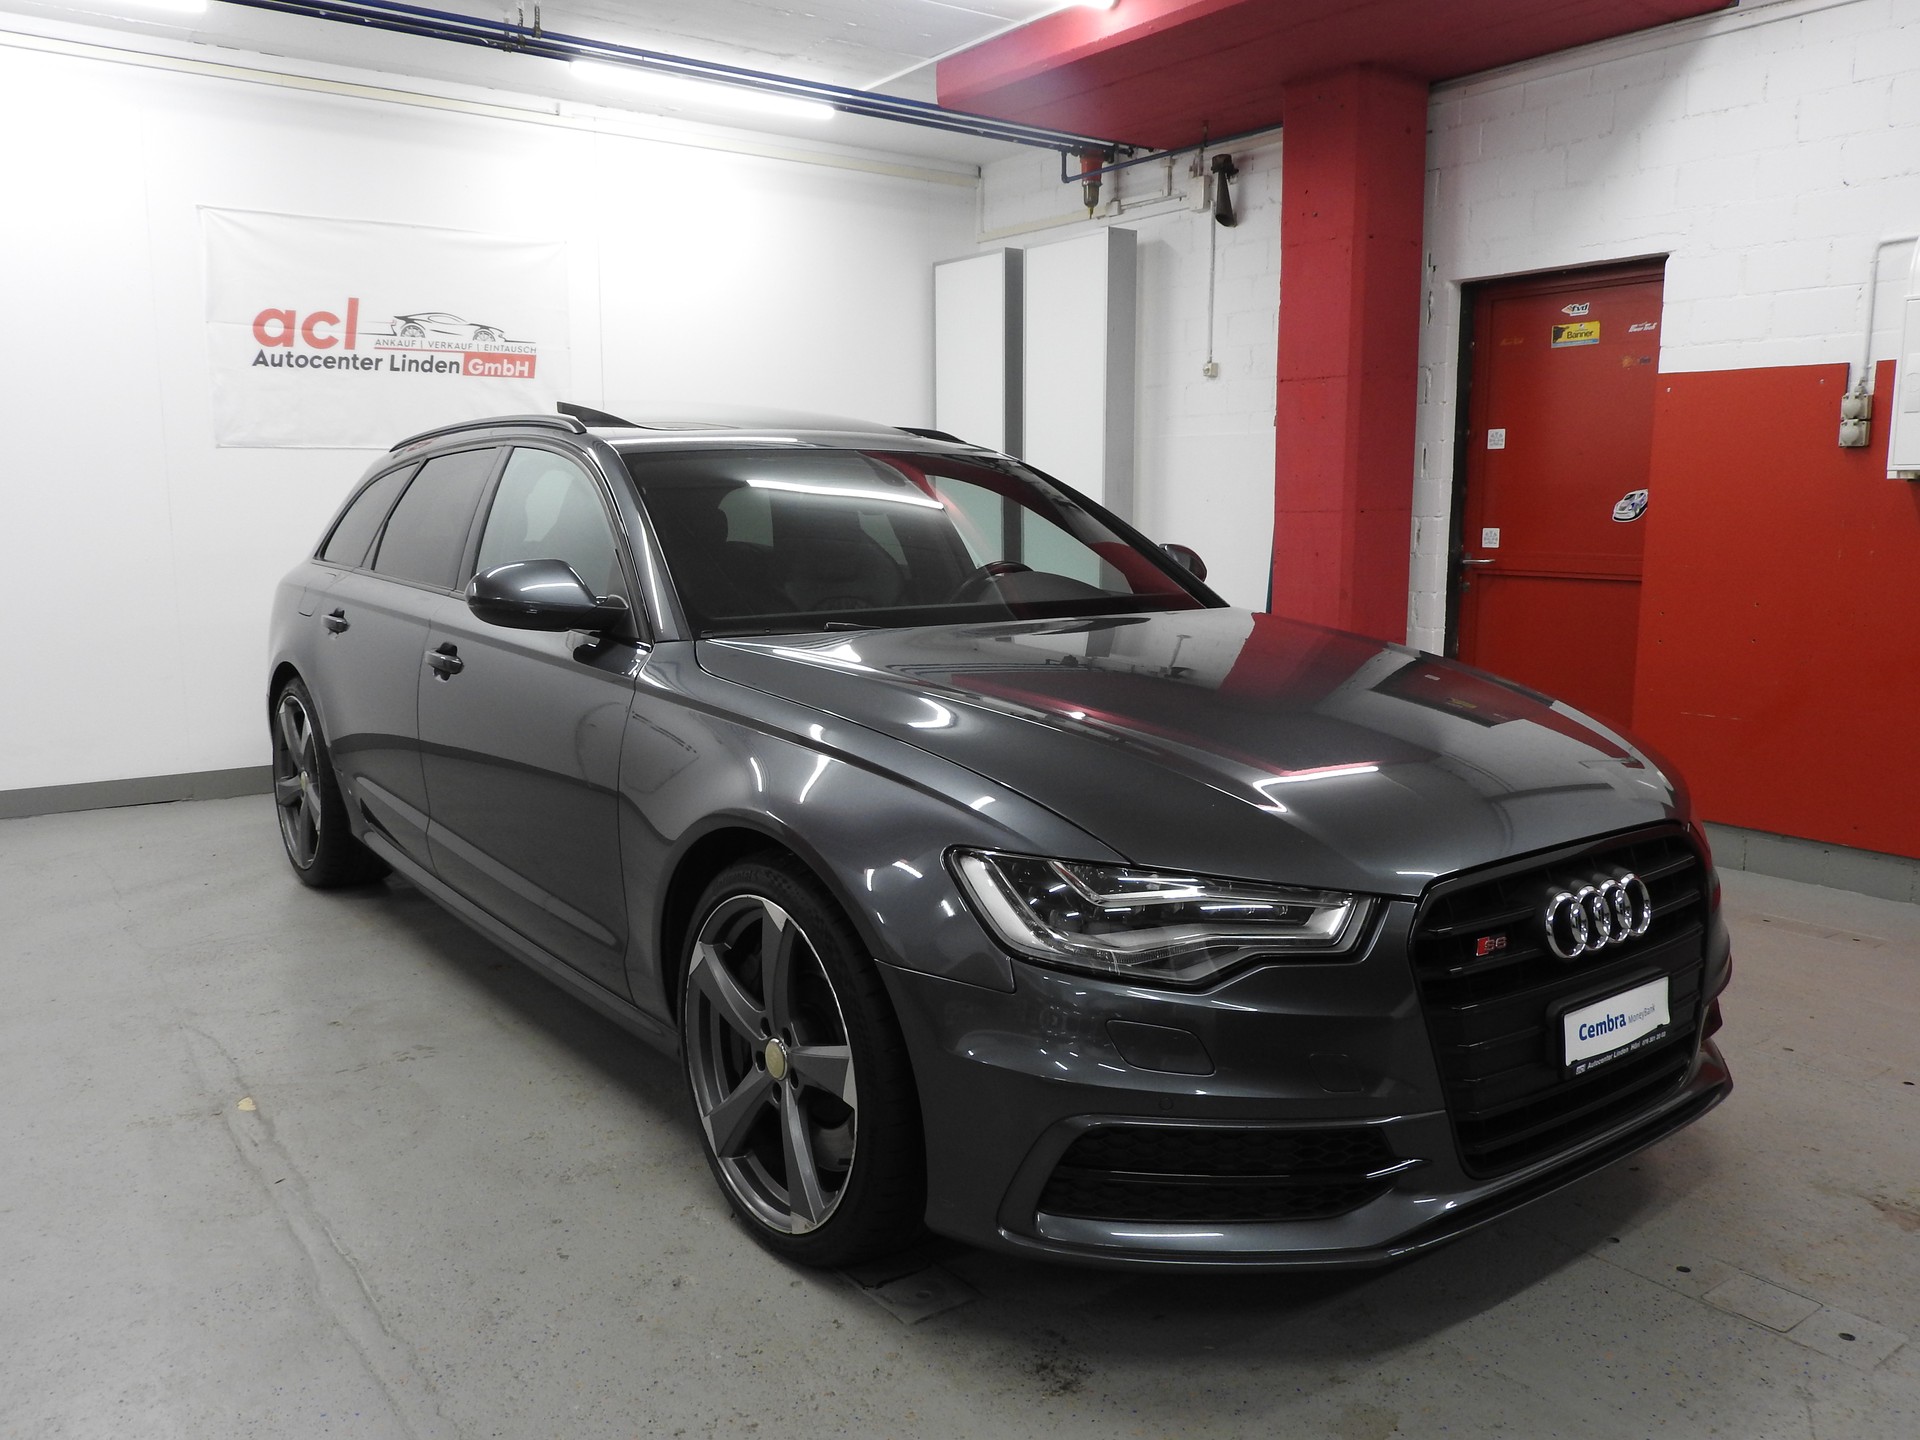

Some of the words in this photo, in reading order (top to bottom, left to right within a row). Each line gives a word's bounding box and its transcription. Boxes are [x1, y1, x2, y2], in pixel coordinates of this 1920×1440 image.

[252, 297, 359, 350] acl
[1566, 330, 1594, 339] Banner
[375, 338, 416, 348] ANKAUF
[428, 340, 473, 351] VERKAUF
[484, 344, 537, 354] EINTAUSCH
[252, 349, 383, 371] Autocenter
[389, 354, 460, 374] Linden
[467, 358, 529, 376] GmbH
[1578, 1013, 1627, 1041] Cembra
